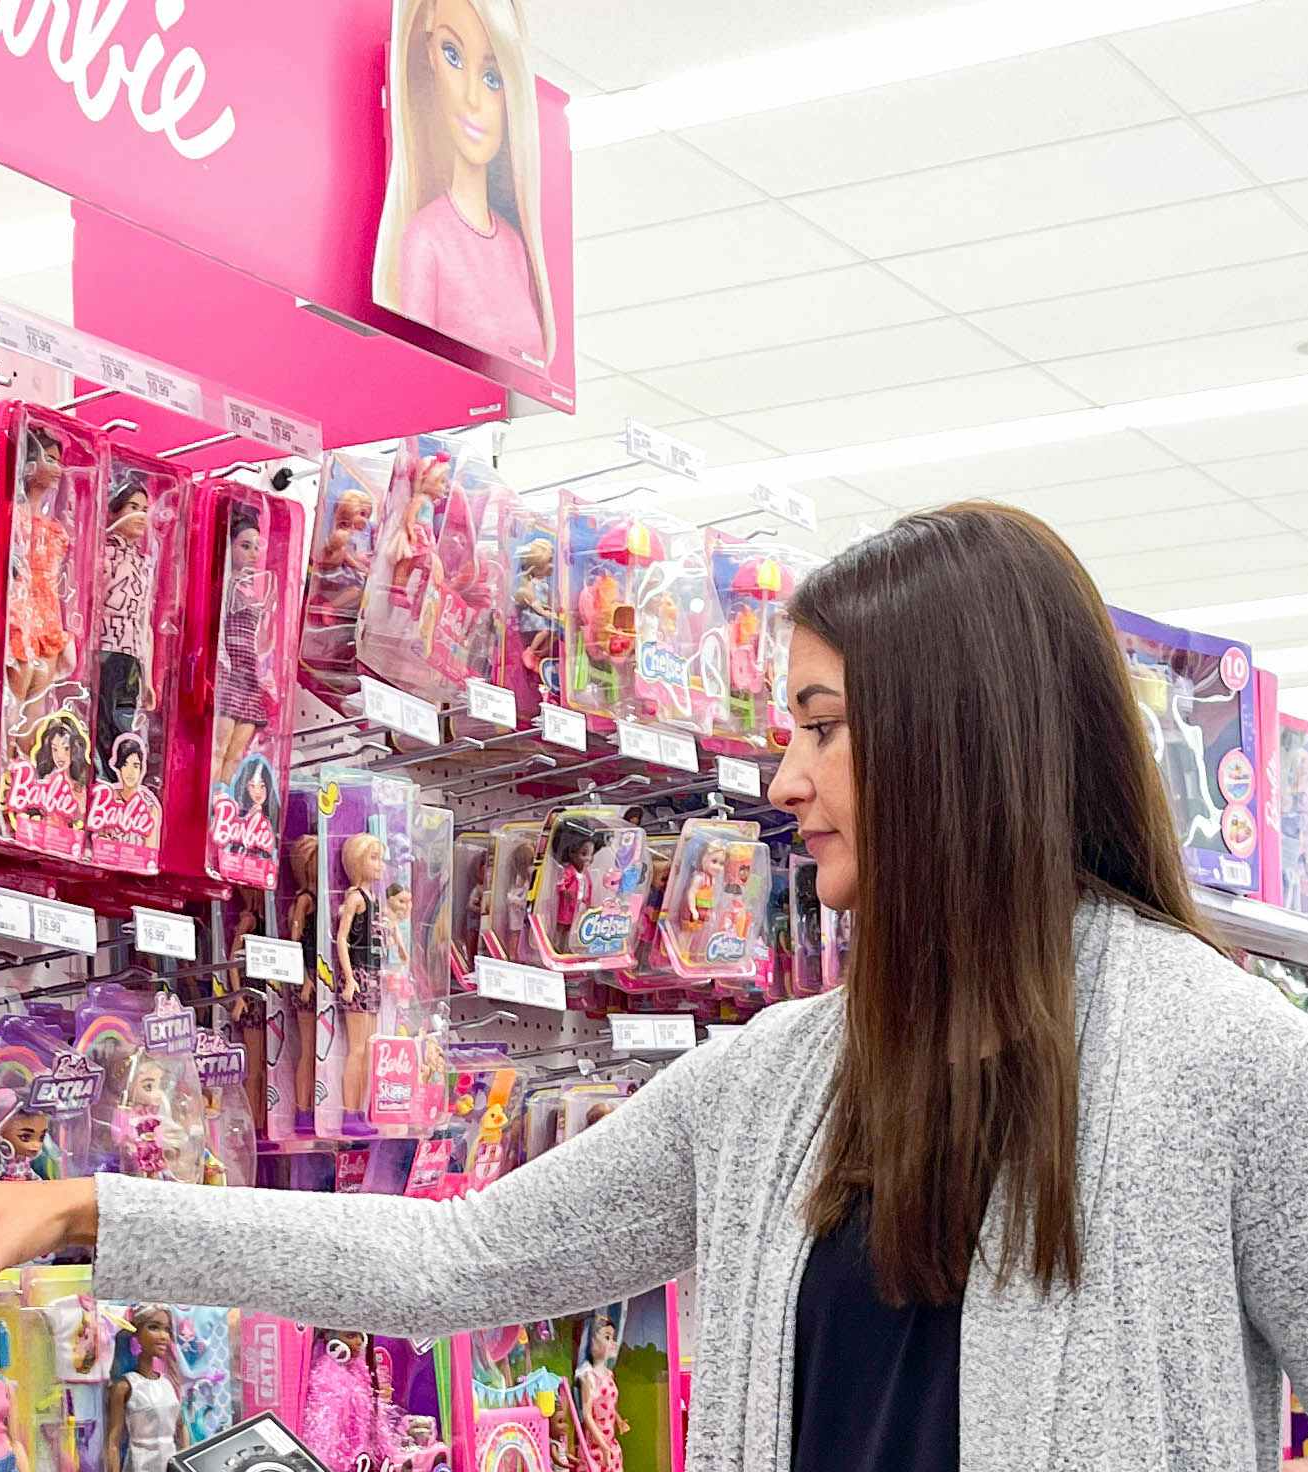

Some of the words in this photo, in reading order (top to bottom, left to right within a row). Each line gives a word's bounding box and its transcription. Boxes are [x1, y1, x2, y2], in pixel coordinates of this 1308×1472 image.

[8, 763, 79, 814] Barbie
[88, 783, 155, 835] Barbie
[214, 803, 273, 850] Barbie
[150, 1020, 191, 1040] EXTRA
[198, 1056, 241, 1076] XTRA
[37, 1082, 93, 1107] EXTRA
